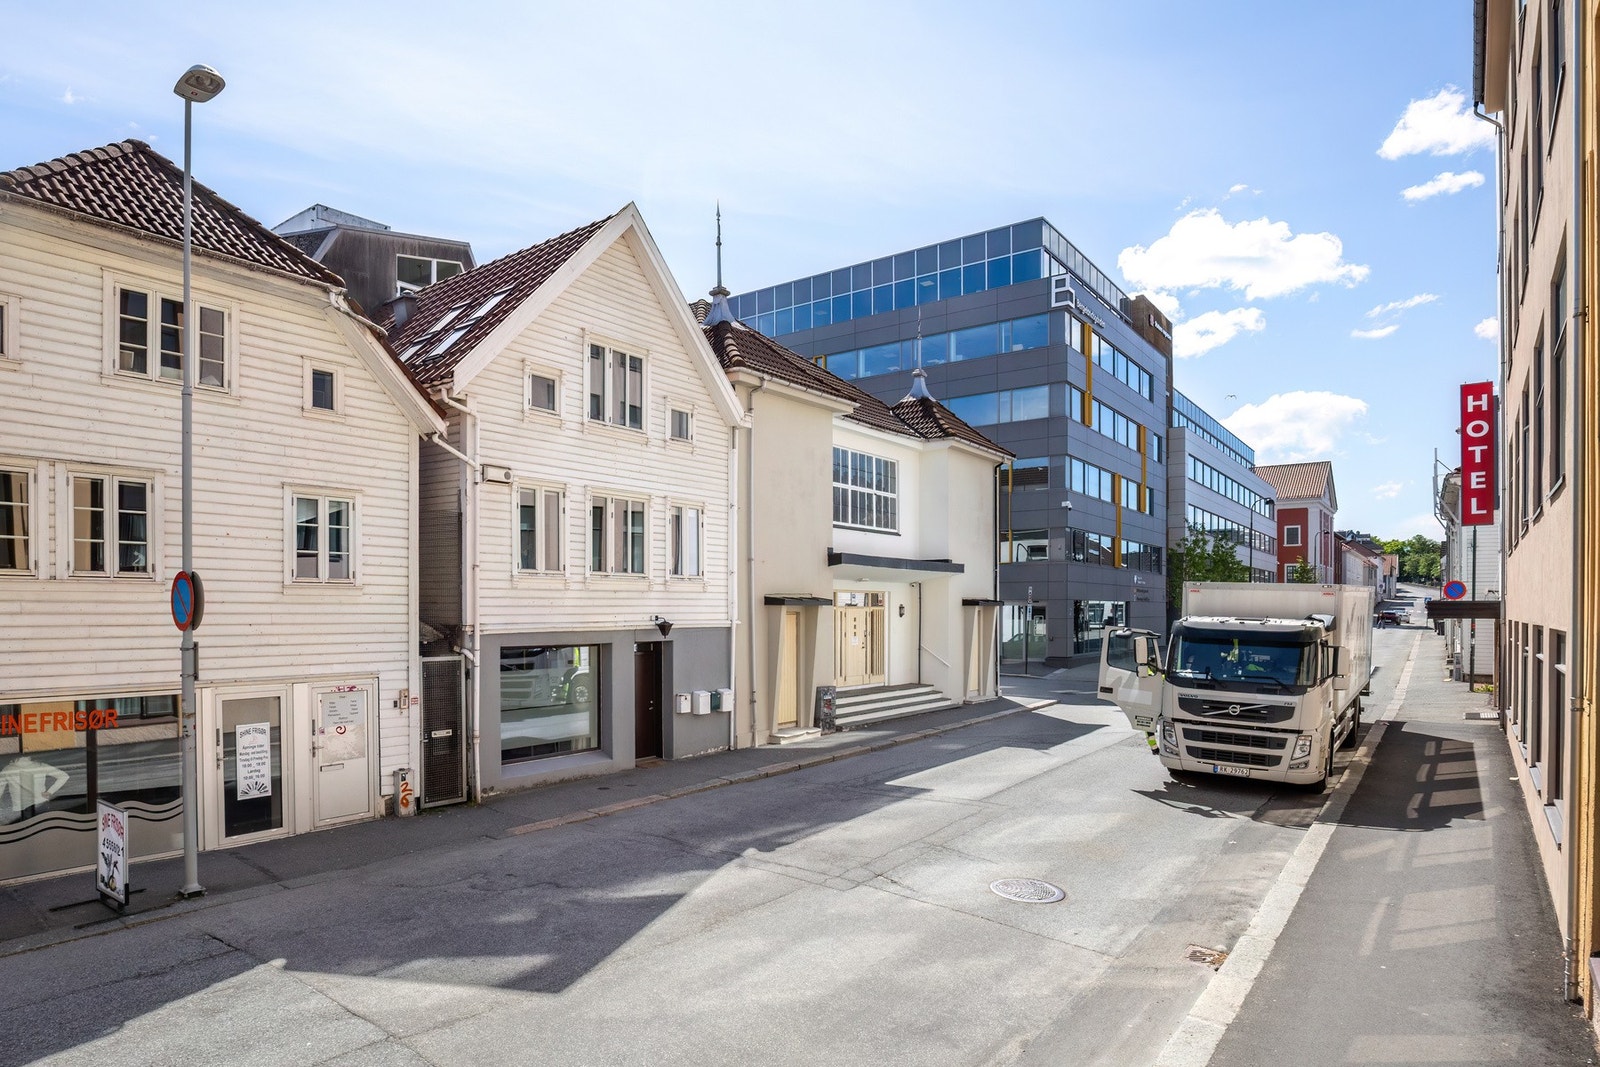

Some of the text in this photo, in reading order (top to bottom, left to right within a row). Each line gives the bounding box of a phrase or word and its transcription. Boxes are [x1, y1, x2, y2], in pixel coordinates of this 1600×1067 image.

[1465, 393, 1490, 516] HOTEL
[239, 727, 267, 739] SHINE FRISØR
